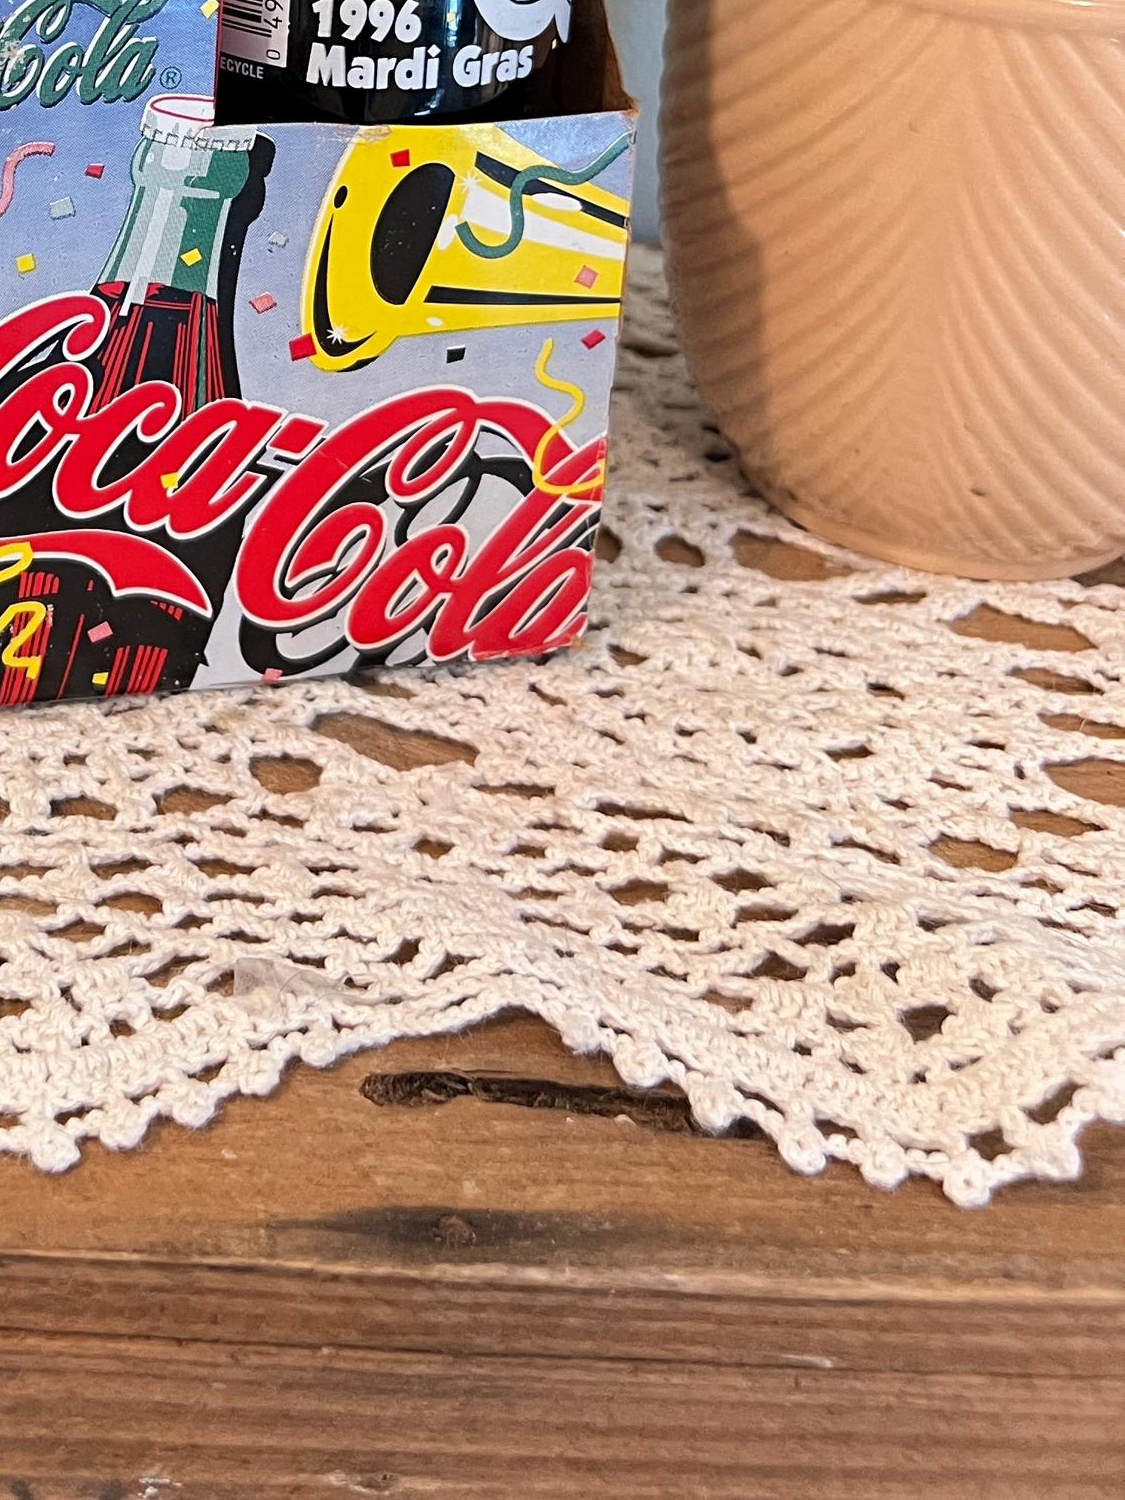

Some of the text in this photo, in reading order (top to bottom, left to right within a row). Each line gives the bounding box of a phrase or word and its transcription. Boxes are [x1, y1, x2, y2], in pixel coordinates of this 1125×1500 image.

[220, 57, 264, 79] ECYCLE
[305, 42, 534, 90] Mardi Gras
